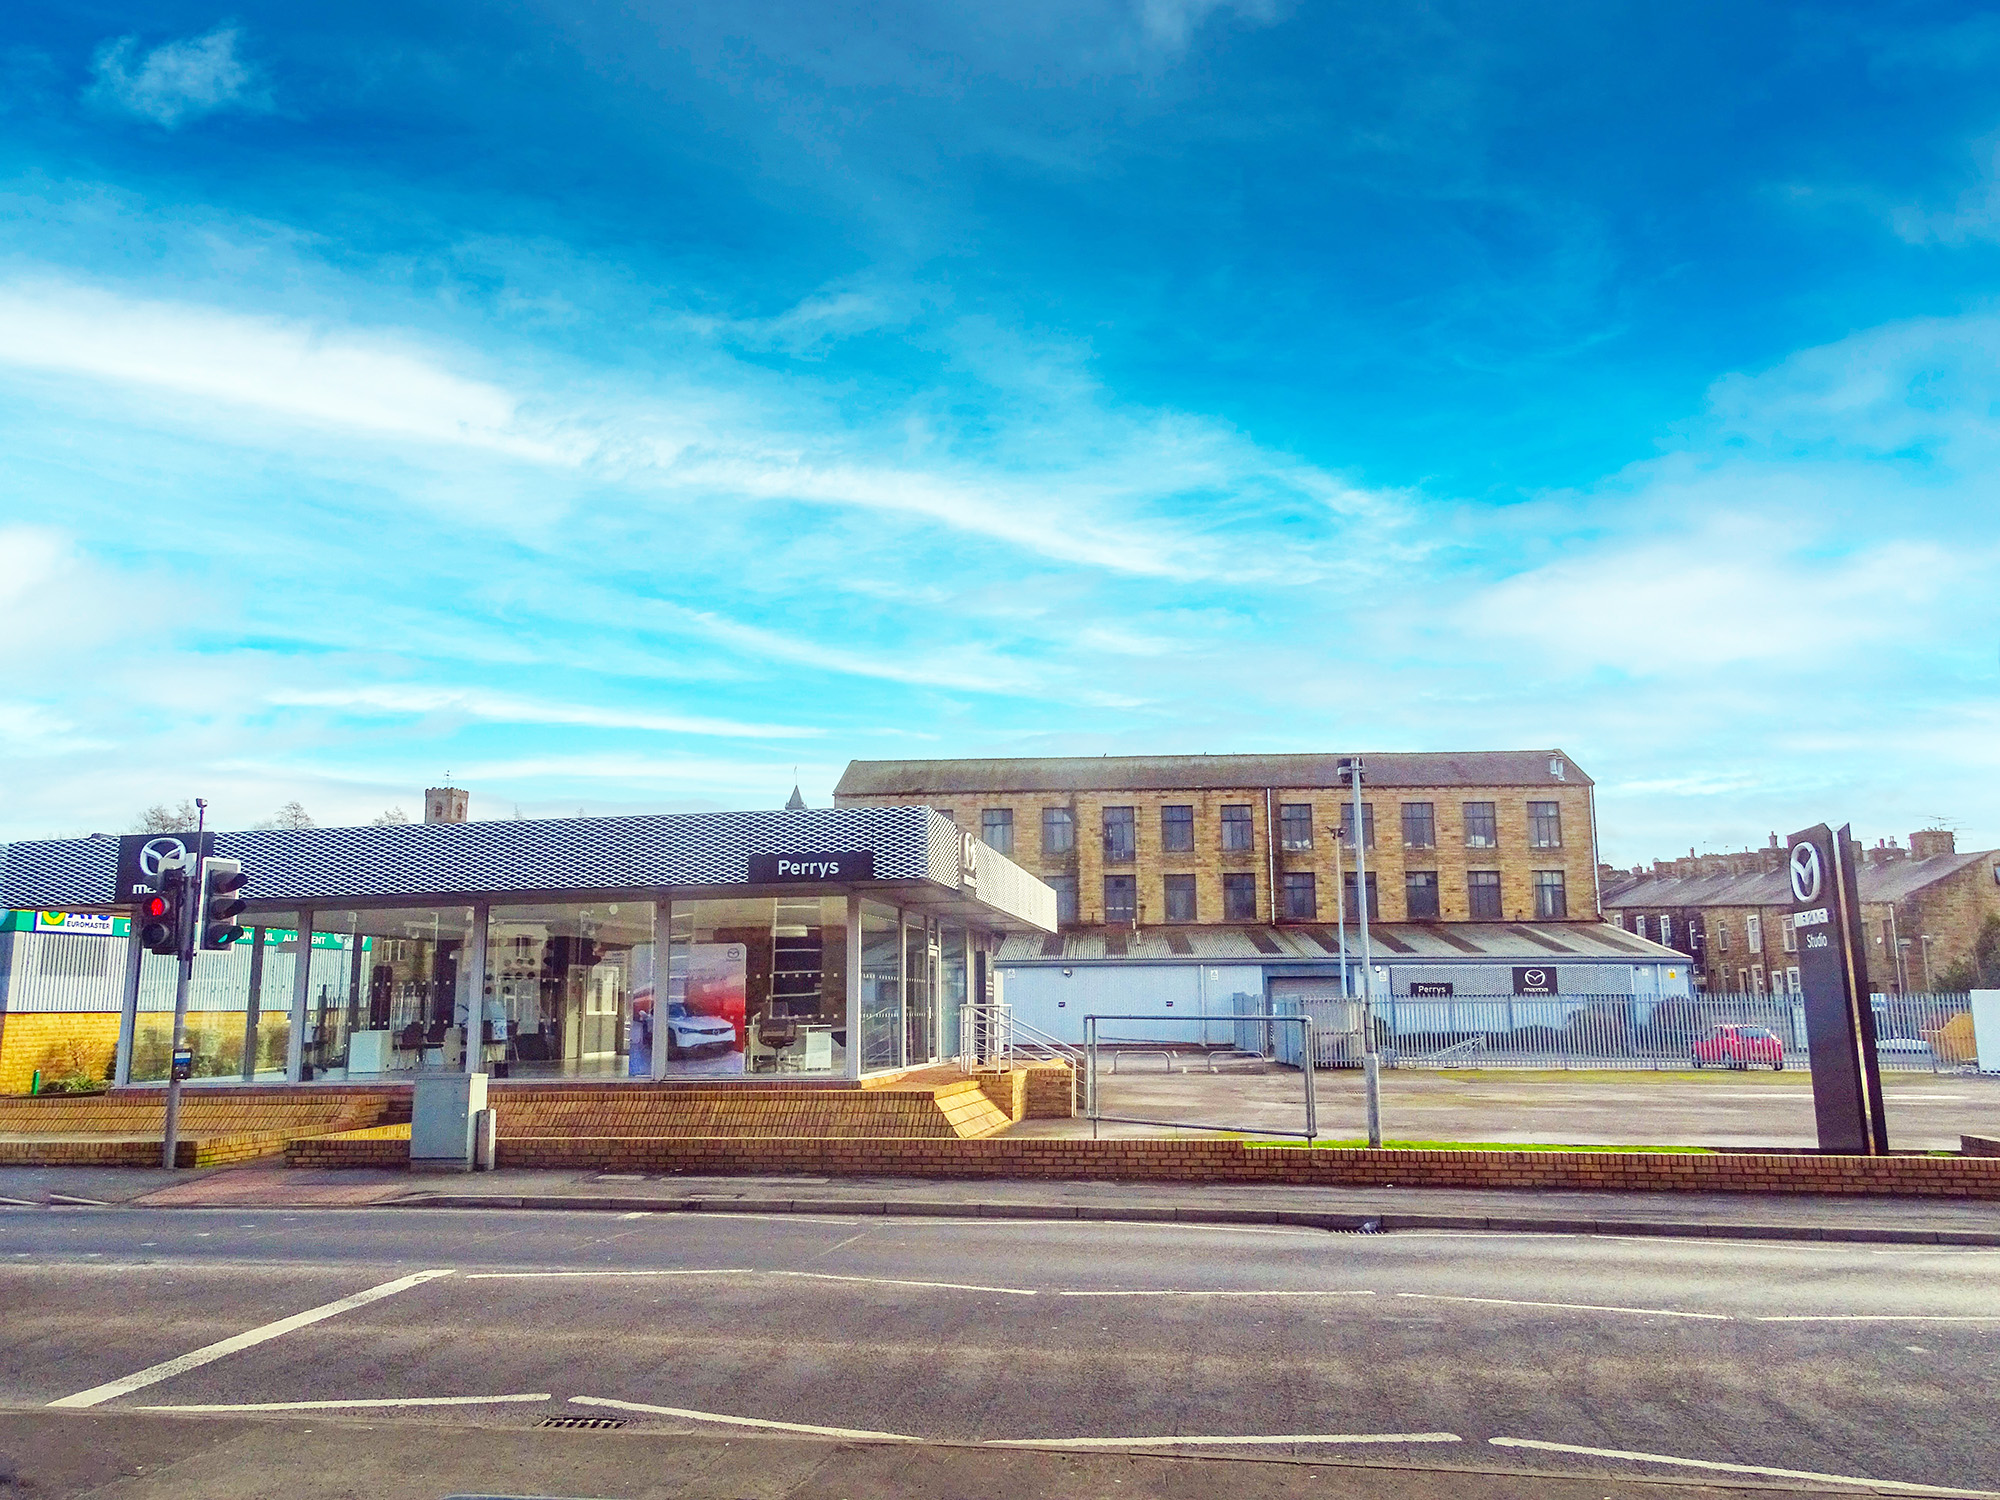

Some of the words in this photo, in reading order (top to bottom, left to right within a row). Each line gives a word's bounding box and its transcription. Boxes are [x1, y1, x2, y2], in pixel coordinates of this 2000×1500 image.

[778, 859, 839, 878] Perrys
[66, 920, 111, 930] EUROMASTER
[1806, 932, 1828, 948] Studio
[1418, 985, 1446, 995] Perrys
